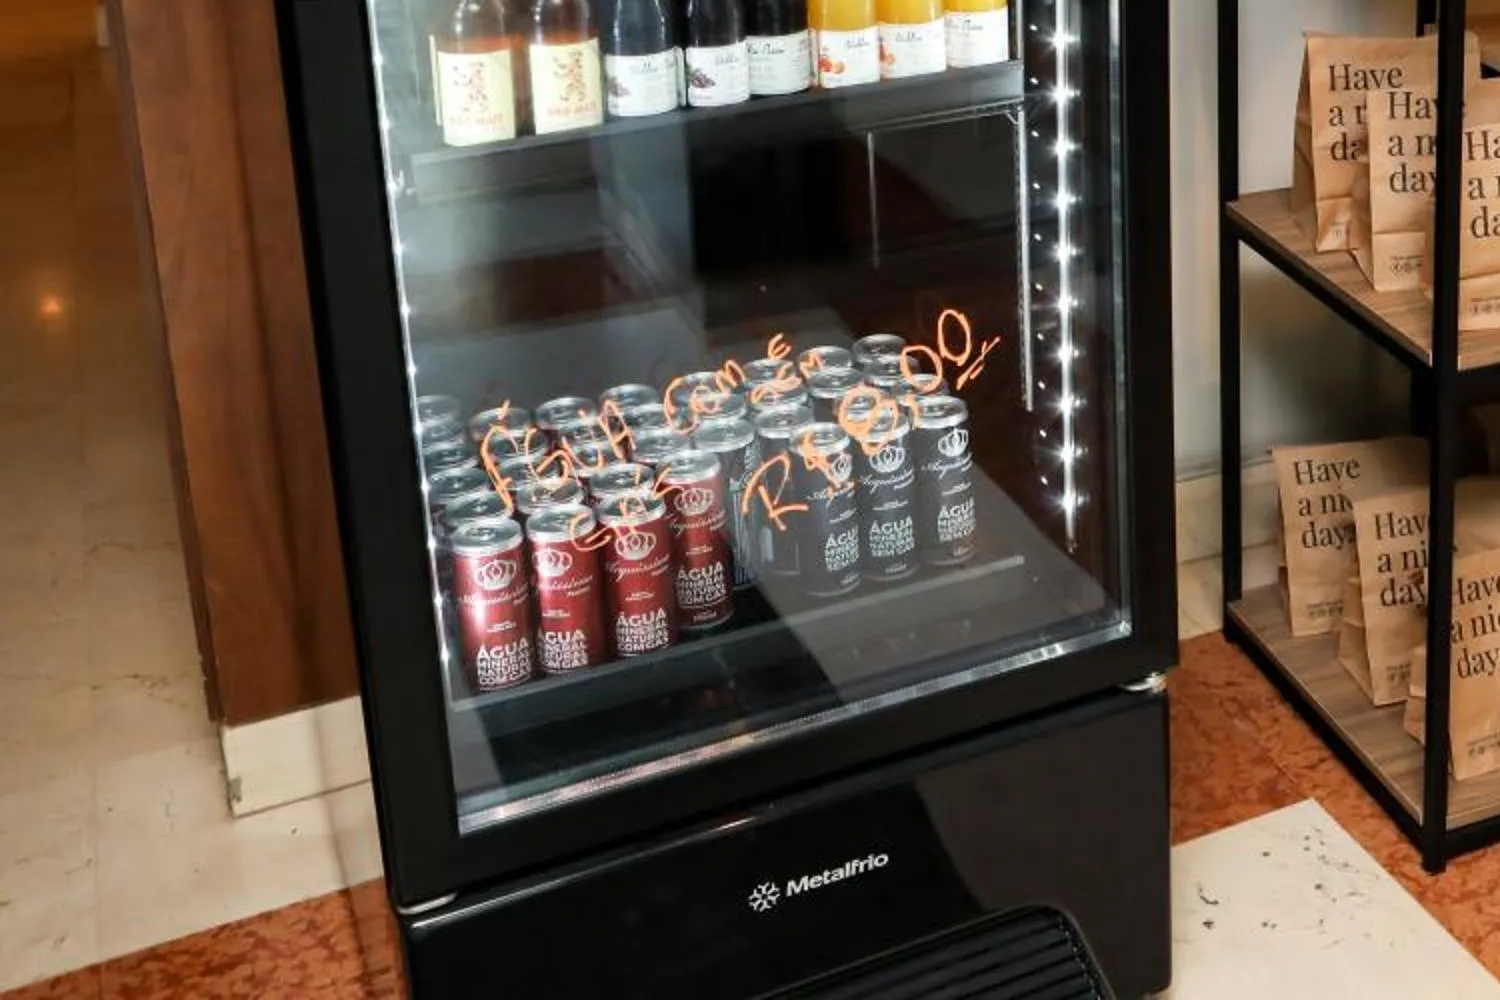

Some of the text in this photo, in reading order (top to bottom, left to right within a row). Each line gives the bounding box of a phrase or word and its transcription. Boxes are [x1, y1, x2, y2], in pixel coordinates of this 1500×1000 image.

[1328, 64, 1404, 91] Have
[1329, 105, 1345, 126] a
[1388, 134, 1404, 157] a
[1467, 177, 1486, 201] a
[1294, 458, 1361, 485] Have
[1298, 496, 1312, 518] a
[870, 515, 913, 534] ÁGUA
[677, 561, 725, 580] ÁGUA
[1377, 552, 1392, 574] a
[616, 608, 667, 627] ÁGUA
[1450, 620, 1464, 644] a
[786, 853, 889, 897] Metalfrio
